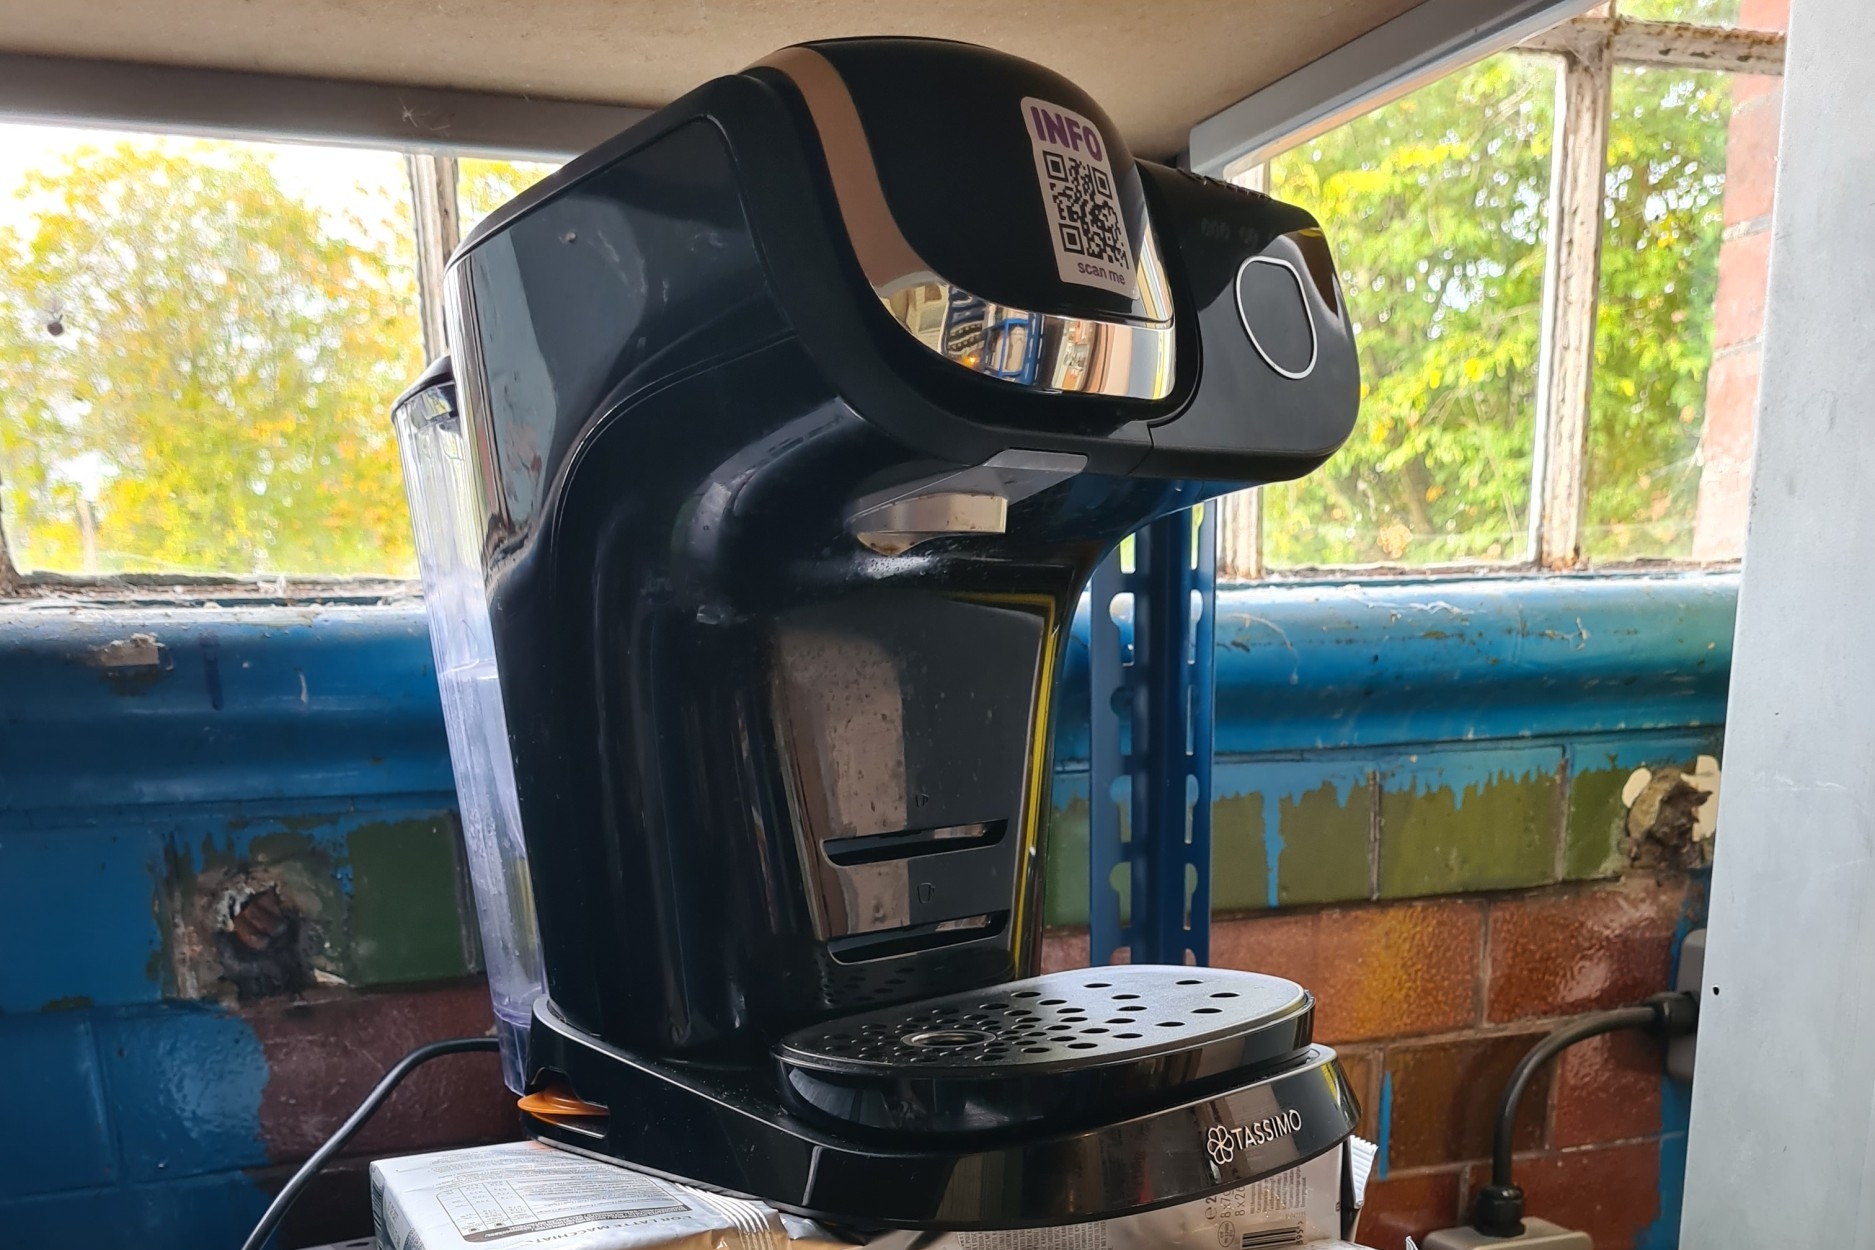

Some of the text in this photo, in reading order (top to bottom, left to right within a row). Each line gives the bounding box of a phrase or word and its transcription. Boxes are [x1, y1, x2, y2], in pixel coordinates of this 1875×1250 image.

[1031, 106, 1102, 162] INFO
[1078, 263, 1126, 285] scan me
[1232, 1109, 1302, 1150] TASSIMO
